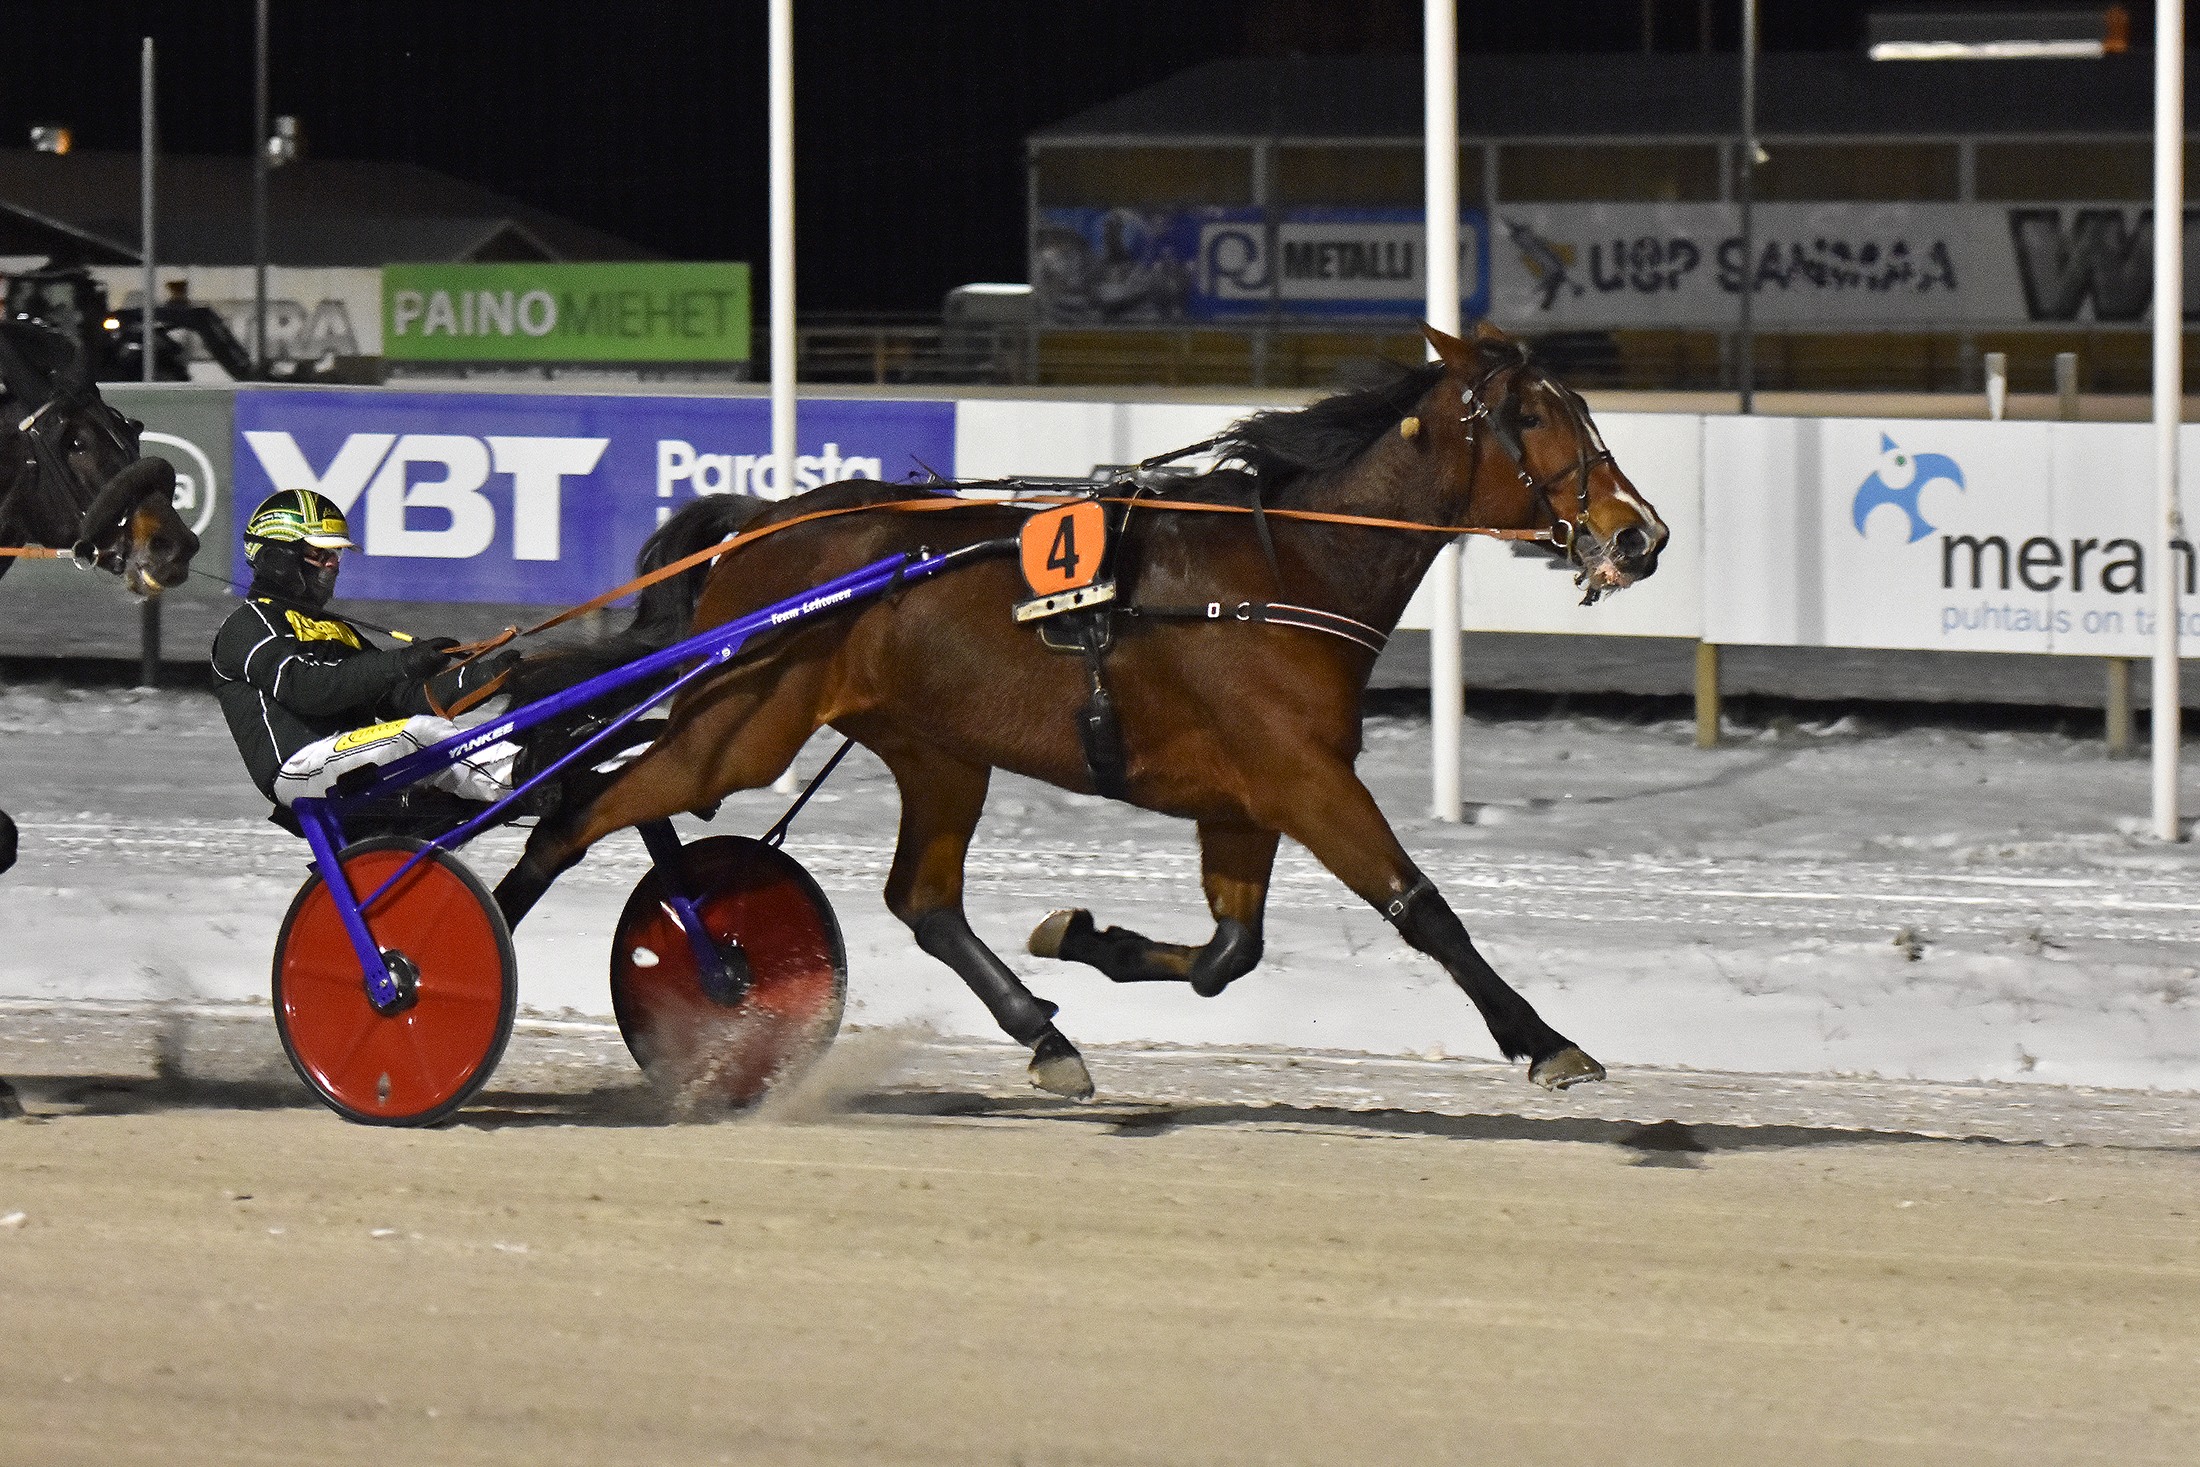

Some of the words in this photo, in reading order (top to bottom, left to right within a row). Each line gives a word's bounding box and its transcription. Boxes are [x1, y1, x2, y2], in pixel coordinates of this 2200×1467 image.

[1284, 241, 1413, 280] METALLI
[241, 431, 611, 561] YBT
[1046, 514, 1080, 580] 4
[1942, 601, 2072, 635] puhtaus
[2082, 610, 2124, 635] on
[449, 722, 515, 758] YANKEE
